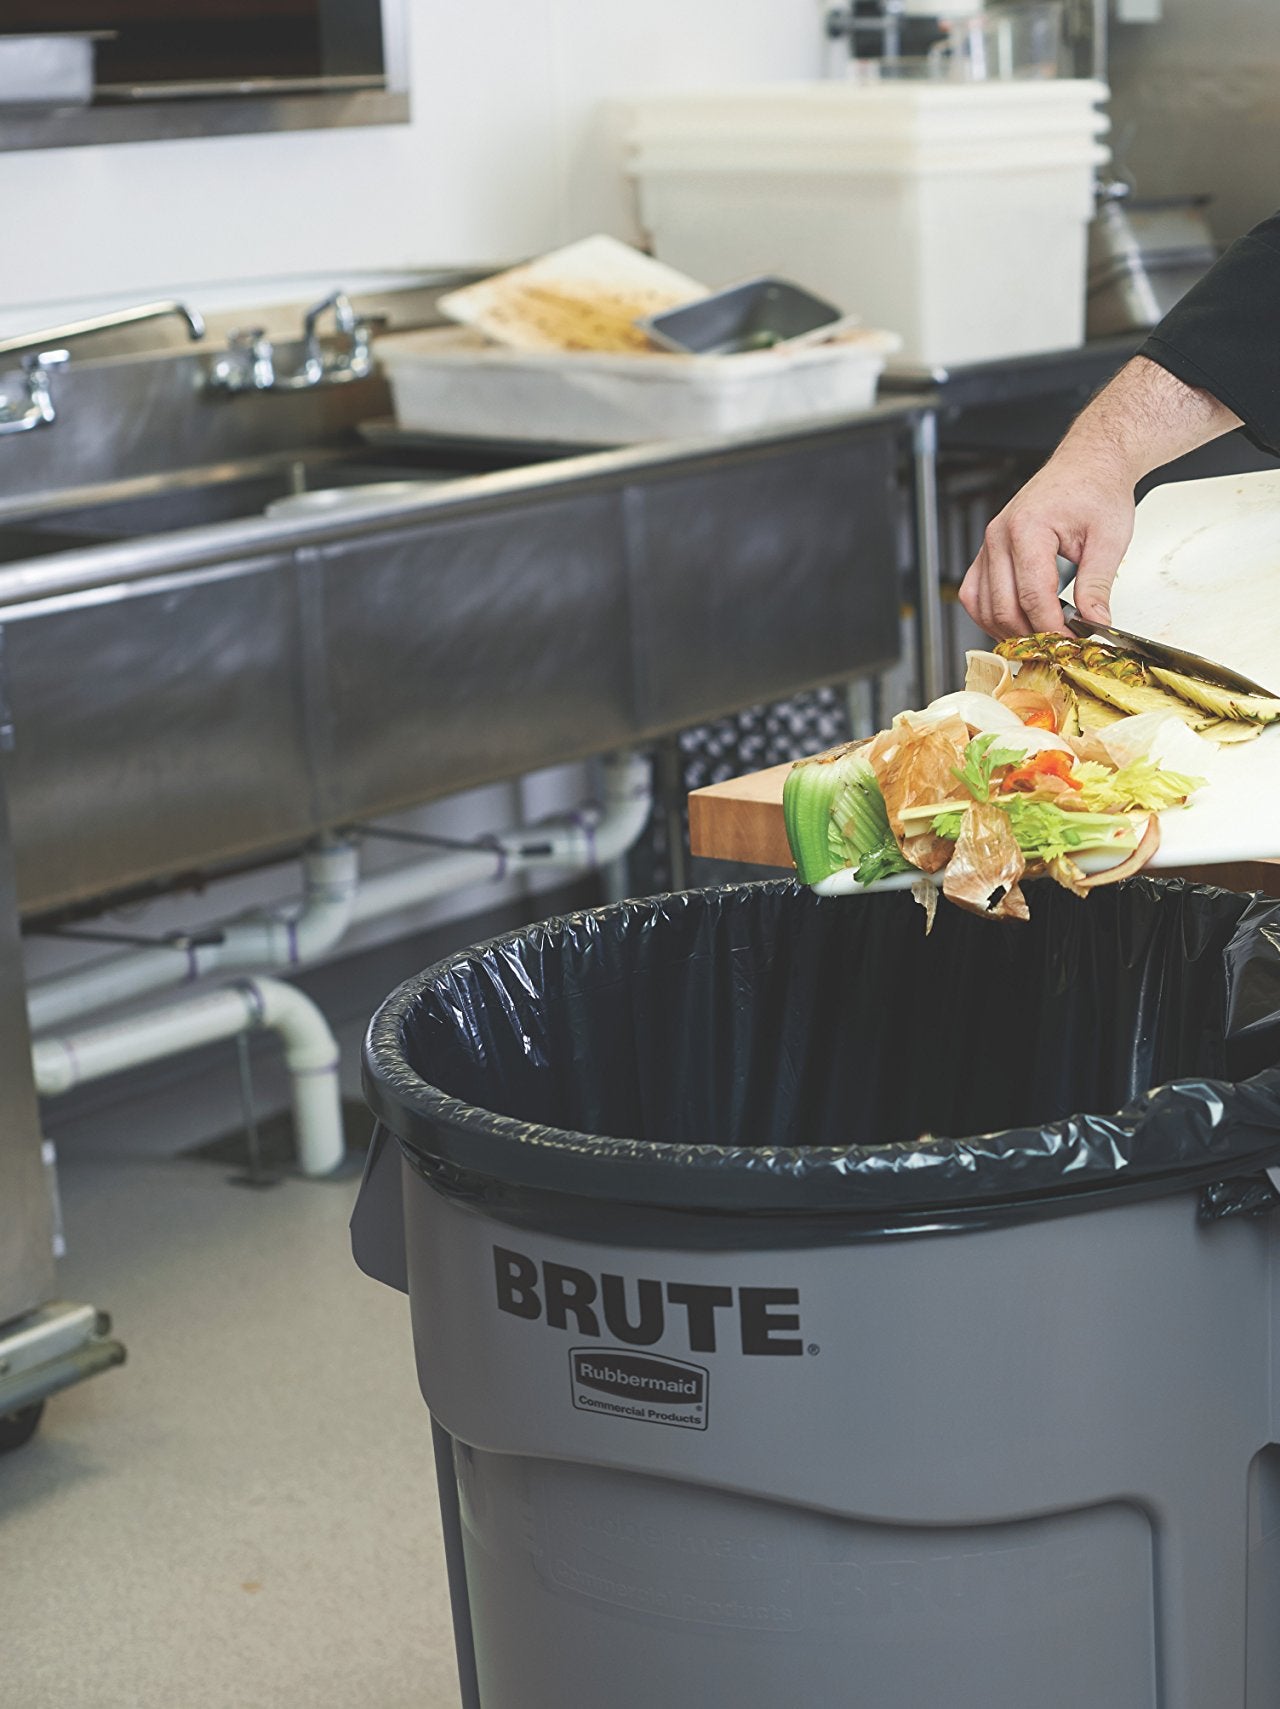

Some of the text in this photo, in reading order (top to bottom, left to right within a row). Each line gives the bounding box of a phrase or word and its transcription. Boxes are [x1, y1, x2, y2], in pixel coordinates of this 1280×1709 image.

[493, 1245, 804, 1356] BRUTE
[580, 1362, 697, 1395] Rubbermaid
[578, 1395, 702, 1425] Commercial Products
